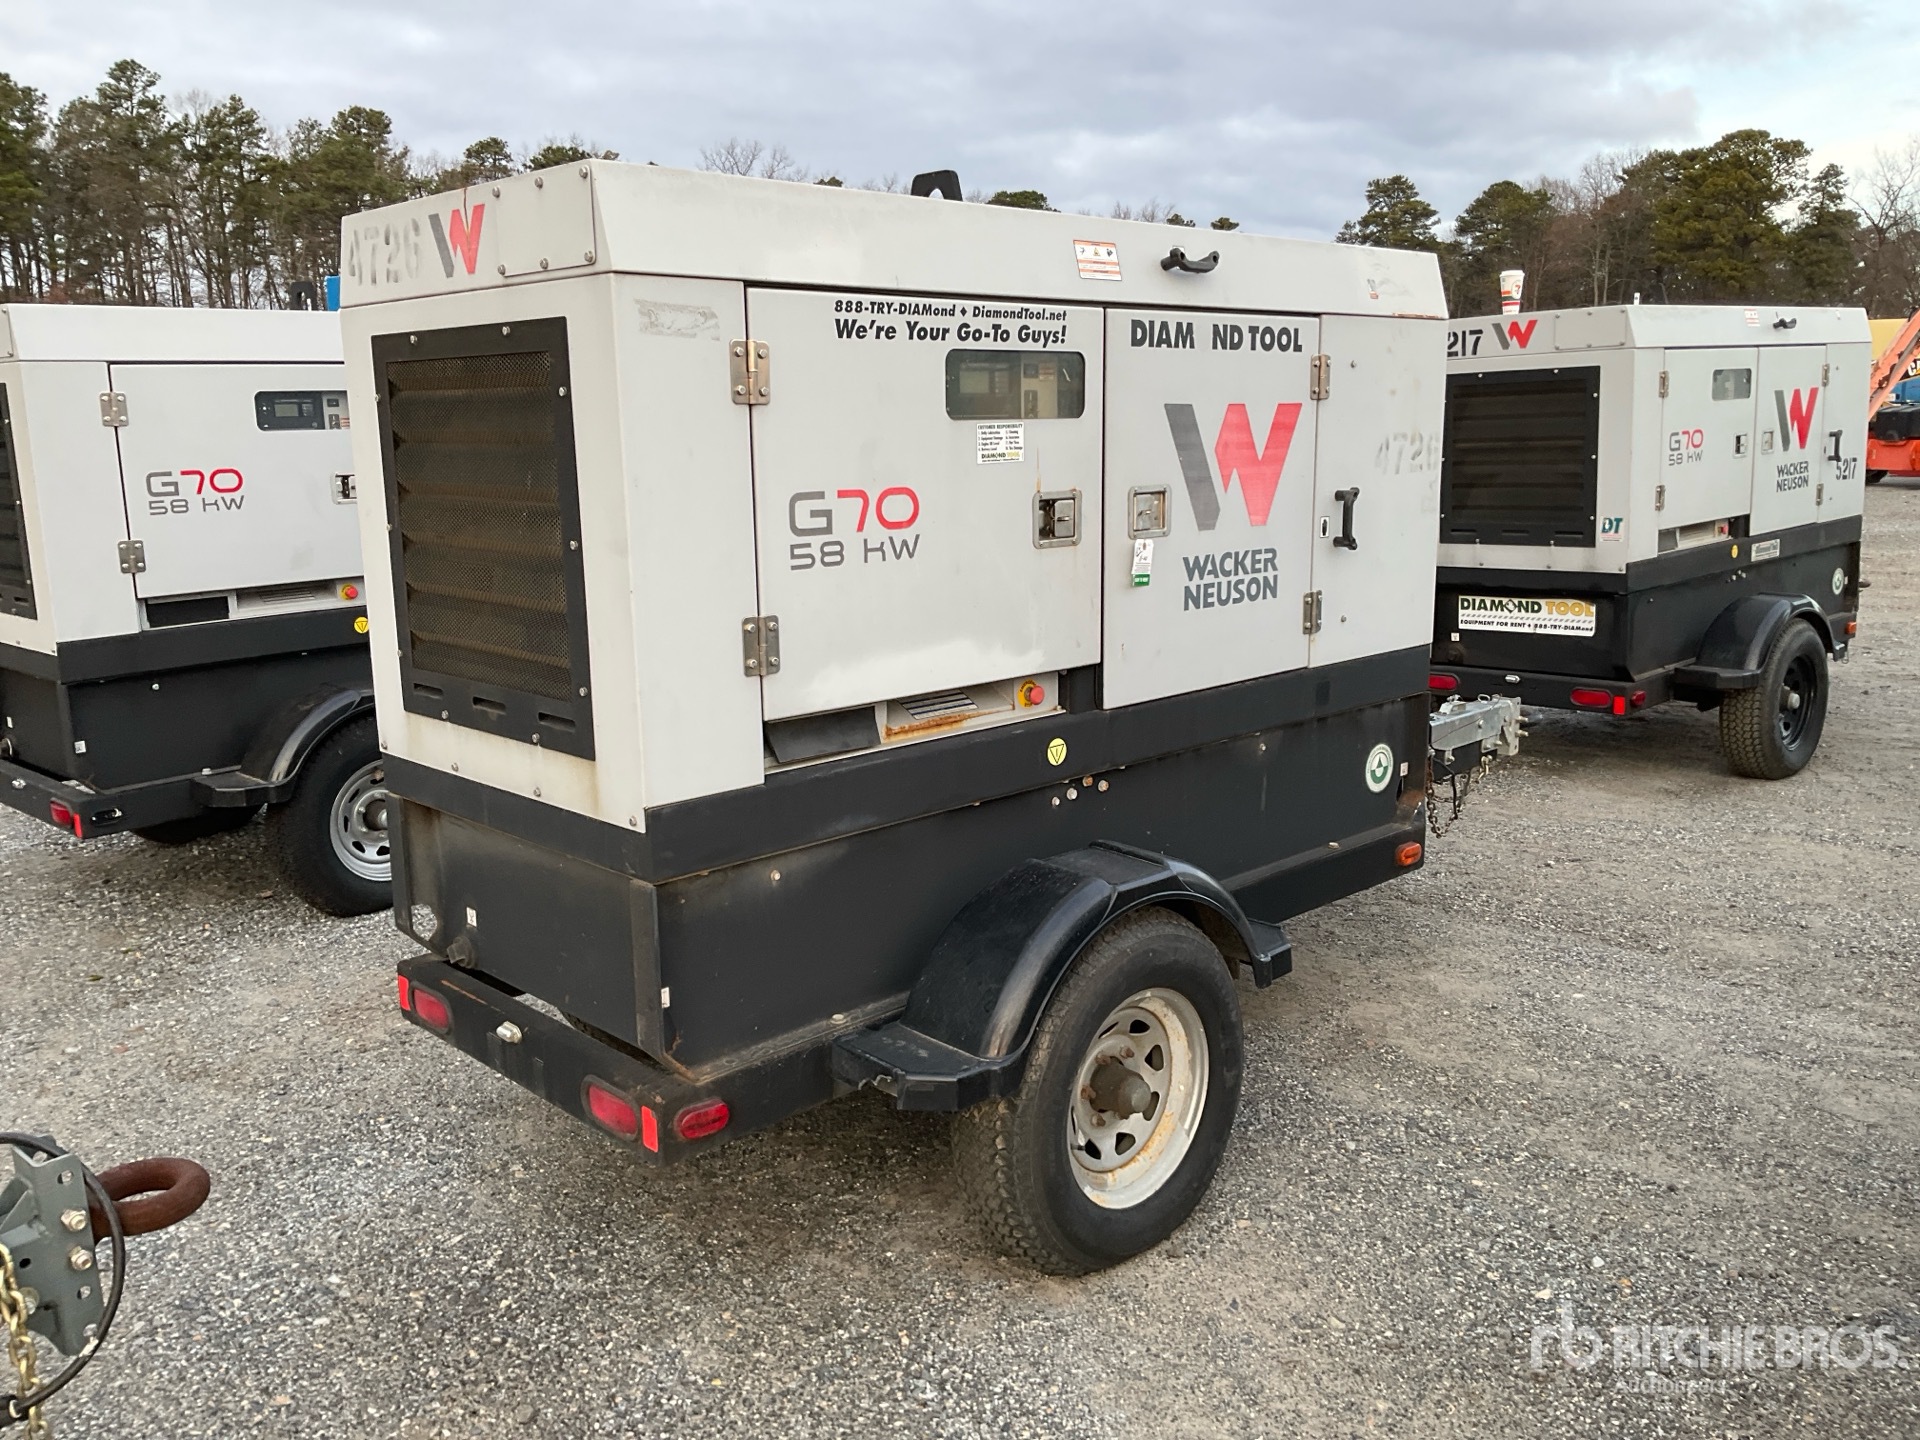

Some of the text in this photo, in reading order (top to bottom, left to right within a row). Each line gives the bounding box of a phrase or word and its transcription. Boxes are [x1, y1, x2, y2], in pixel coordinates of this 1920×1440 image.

[834, 300, 1067, 321] 888-TRY-DIAMond DiamondTool.net
[834, 318, 1067, 348] We're Your Go-To Guys!
[1248, 325, 1303, 353] TOOL
[1669, 429, 1704, 452] G70
[1669, 453, 1683, 466] 58
[1776, 461, 1809, 478] WACKER
[1836, 457, 1857, 480] 5217
[146, 468, 243, 497] G70
[1776, 475, 1809, 493] NEUSON
[149, 498, 189, 515] 58
[789, 486, 920, 537] G70
[1601, 517, 1623, 534] DT
[790, 540, 845, 570] 58
[1182, 548, 1278, 582] WACKER
[1183, 574, 1278, 611] NEUSON
[1545, 601, 1594, 617] TOOL
